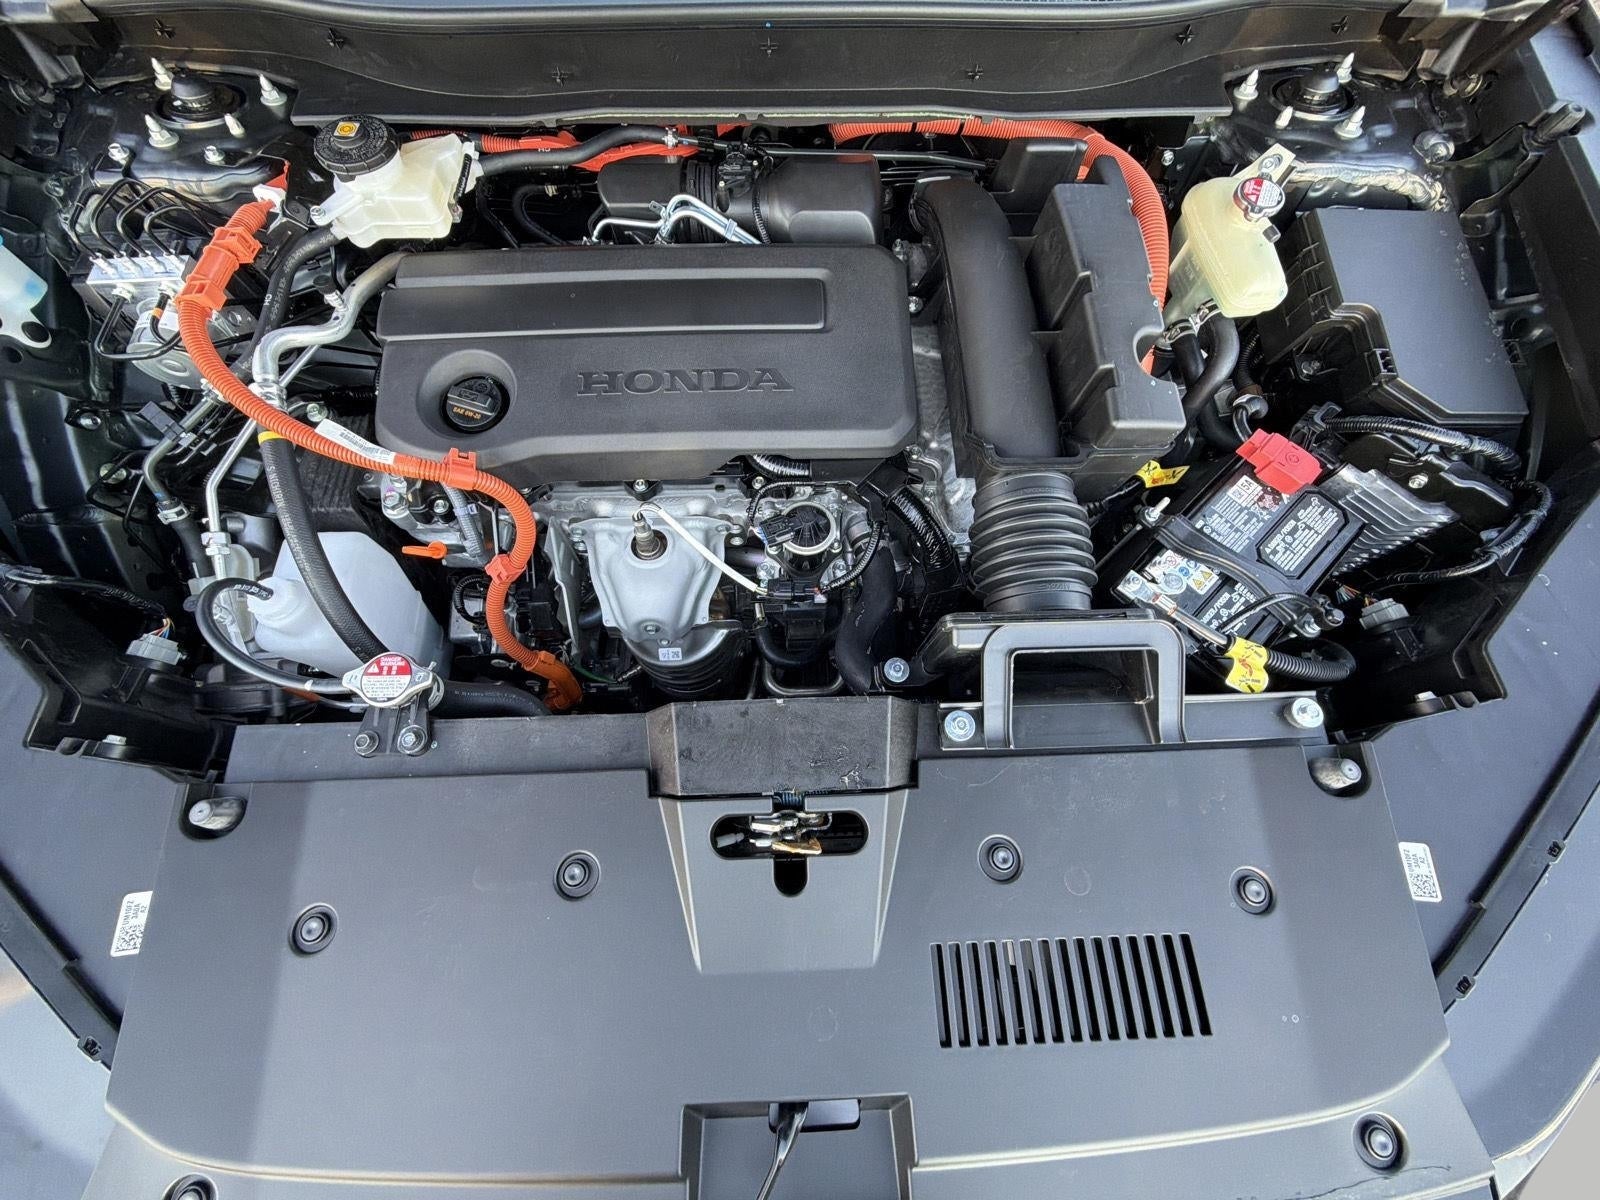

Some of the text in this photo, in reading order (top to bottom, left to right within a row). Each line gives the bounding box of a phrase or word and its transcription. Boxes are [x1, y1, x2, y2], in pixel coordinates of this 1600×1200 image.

[577, 367, 794, 397] HONDA
[452, 406, 482, 420] SAE 0W-20
